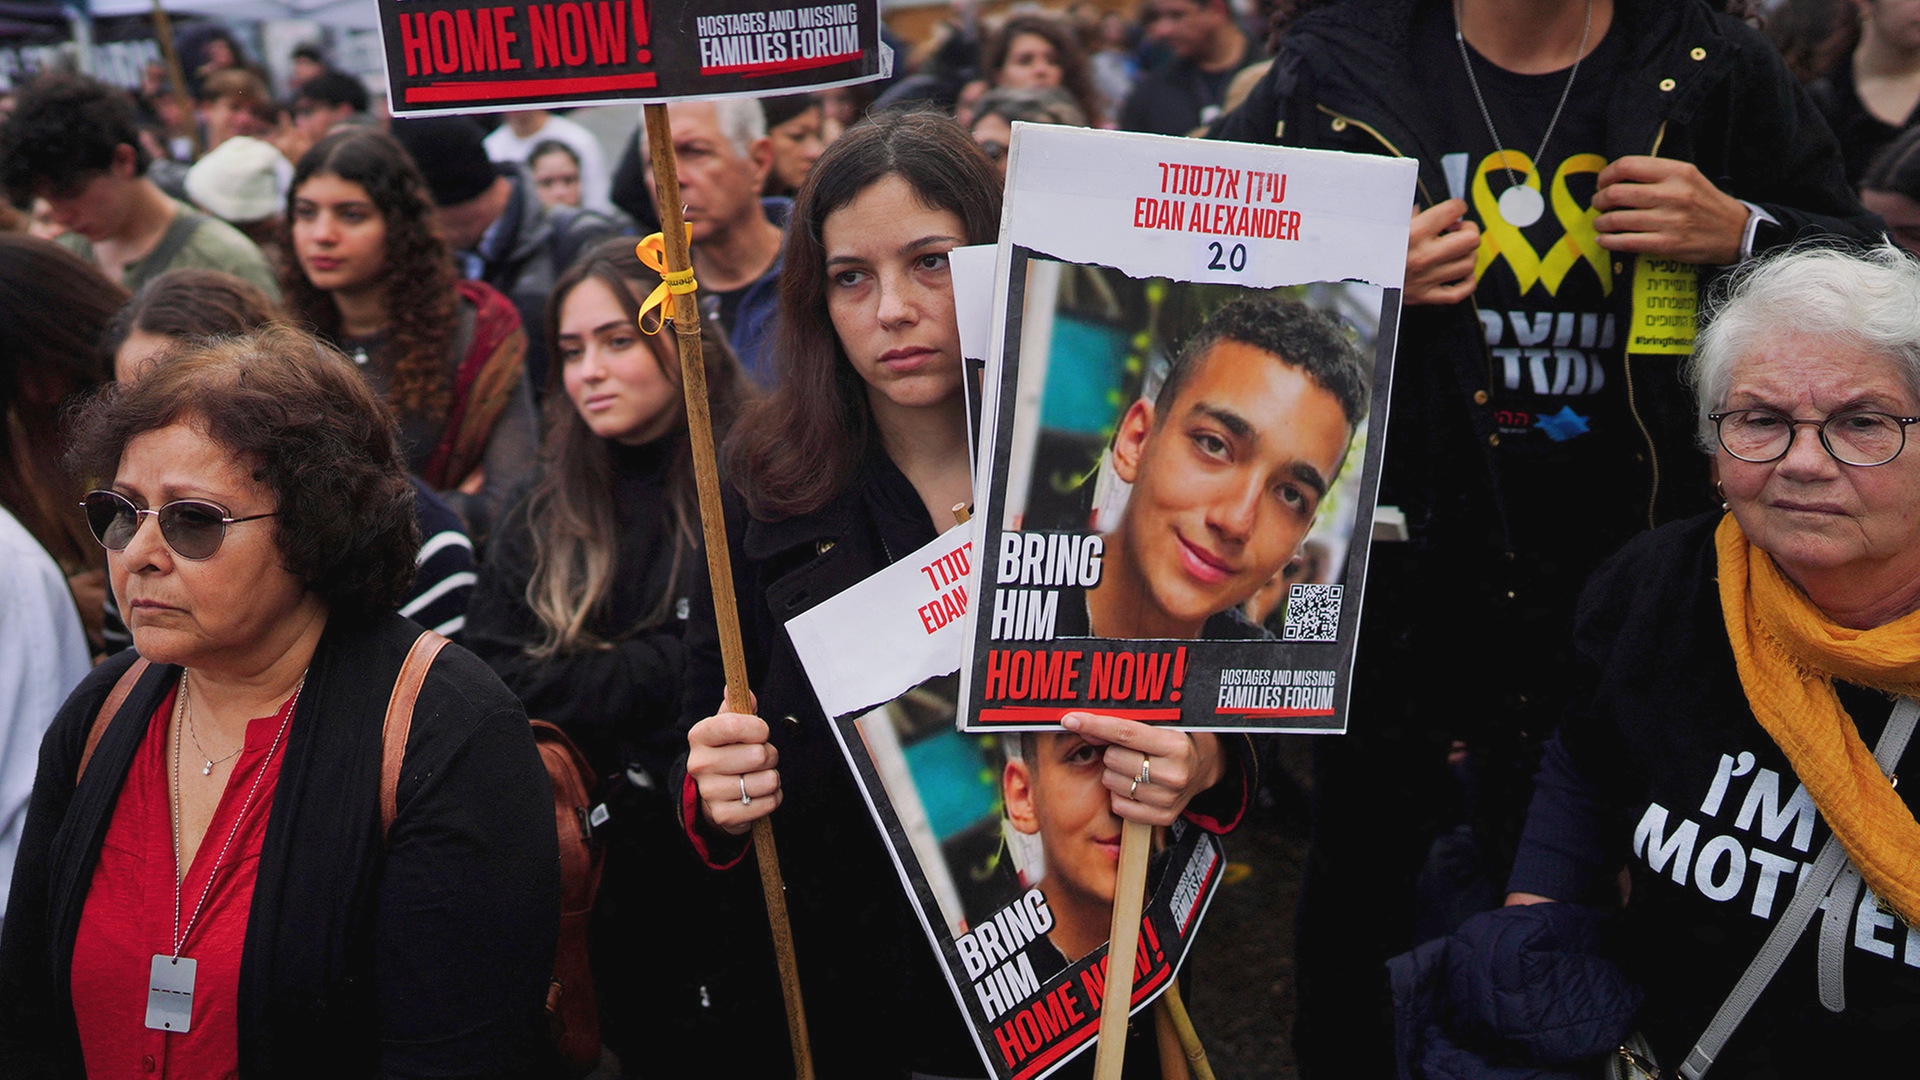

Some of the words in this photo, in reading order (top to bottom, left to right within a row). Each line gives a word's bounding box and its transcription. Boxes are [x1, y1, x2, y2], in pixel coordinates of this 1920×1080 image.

[399, 9, 521, 76] HOME
[528, 0, 653, 69] NOW!
[696, 13, 767, 37] HOSTAGES
[767, 8, 798, 32] AND
[798, 3, 858, 28] MISSING
[699, 28, 788, 68] FAMILIES
[791, 22, 860, 60] FORUM
[1158, 162, 1240, 200] אלכסנדר
[1245, 171, 1287, 205] עידן
[1133, 197, 1186, 231] EDAN
[1188, 202, 1302, 241] ALEXANDER
[1207, 241, 1248, 272] 20
[996, 532, 1104, 587] BRING
[917, 585, 968, 635] EDAN
[990, 589, 1059, 641] HIM
[984, 649, 1082, 701] HOME
[1087, 646, 1190, 702] NOW!
[1217, 686, 1282, 710] FAMILIES
[1283, 687, 1334, 711] FORUM
[1220, 669, 1271, 686] HOSTAGES
[1271, 669, 1292, 686] AND
[1292, 670, 1336, 687] MISSING
[1700, 751, 1818, 852] I'M
[1633, 802, 1920, 968] MOTE
[955, 888, 1053, 982] BRING
[974, 951, 1041, 1023] HIM
[993, 980, 1085, 1069] HOME
